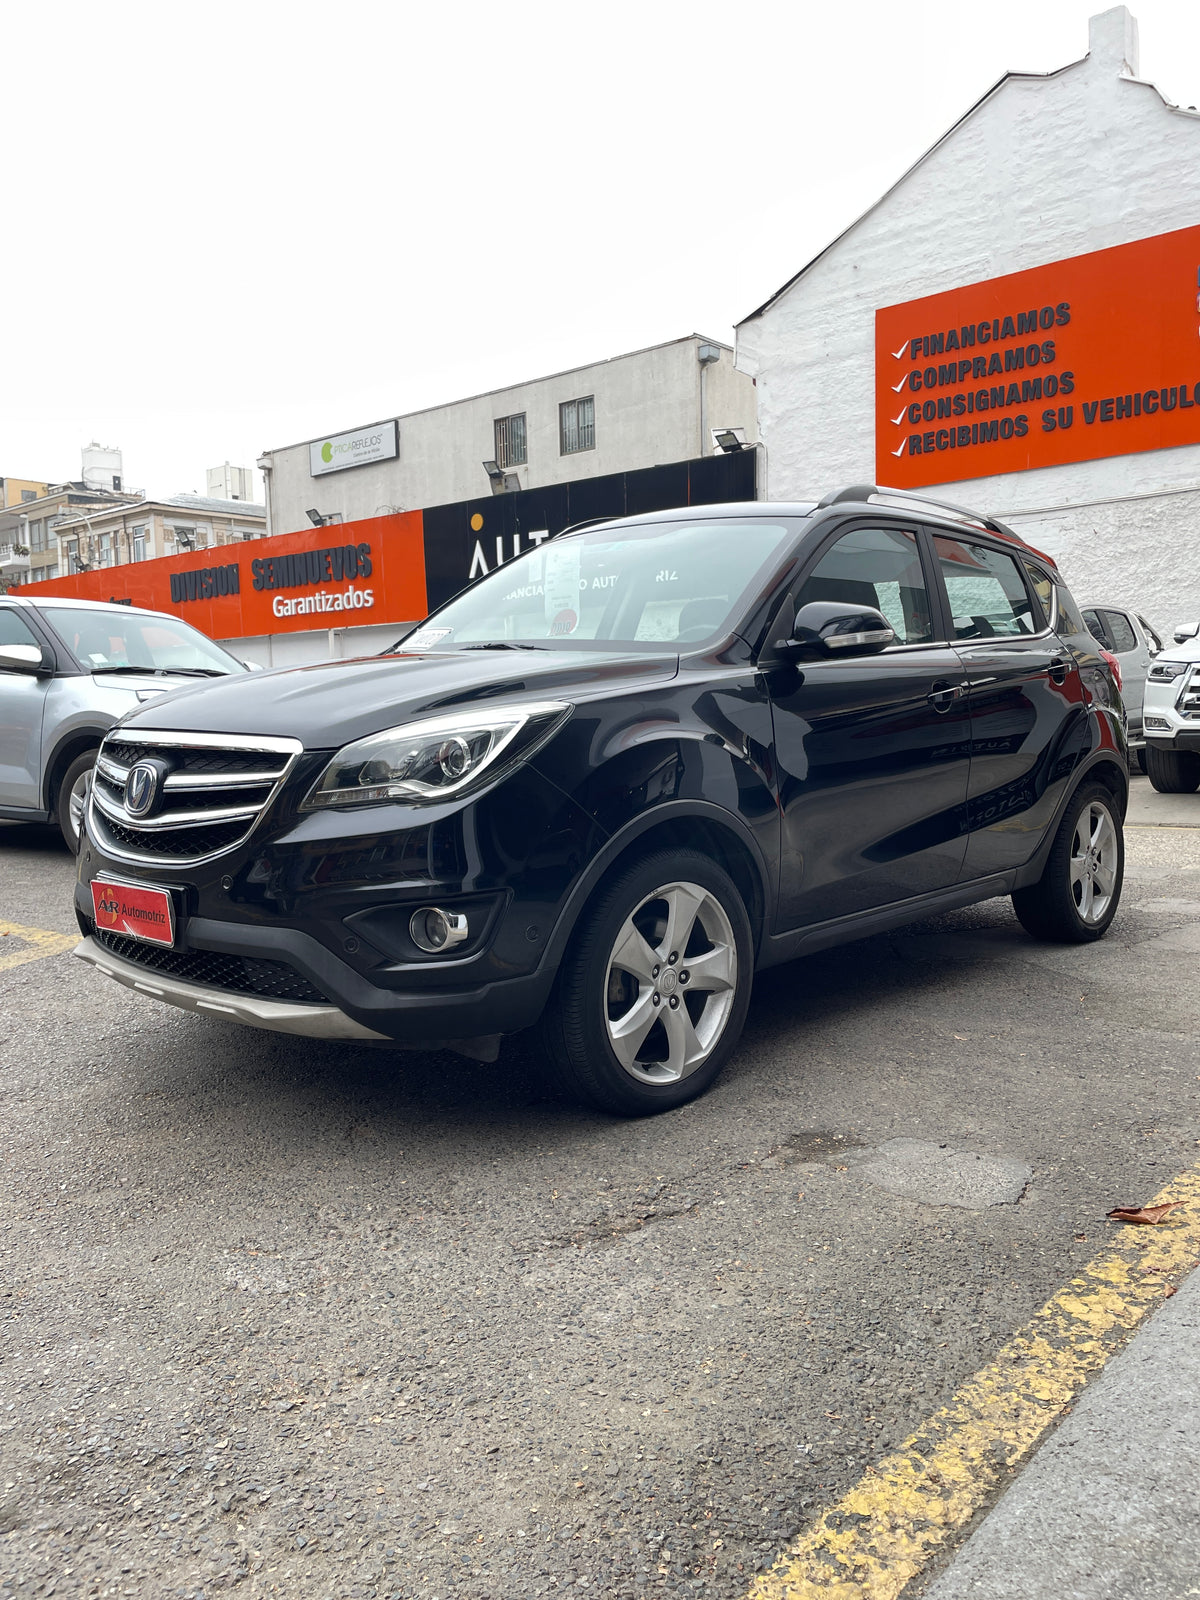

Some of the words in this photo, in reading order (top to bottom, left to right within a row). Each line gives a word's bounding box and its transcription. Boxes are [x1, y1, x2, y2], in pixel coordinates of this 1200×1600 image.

[910, 302, 1071, 360] FINANCIAMOS
[908, 340, 1056, 392] COMPRAMOS
[907, 371, 1075, 424] CONSIGNAMOS
[908, 414, 1029, 456] RECIBIMOS
[1041, 405, 1074, 433] SU
[169, 562, 240, 603] DIVISION
[251, 542, 373, 592] SEMINUEVOS
[272, 585, 374, 618] Garantizados
[121, 903, 166, 924] Automotriz
